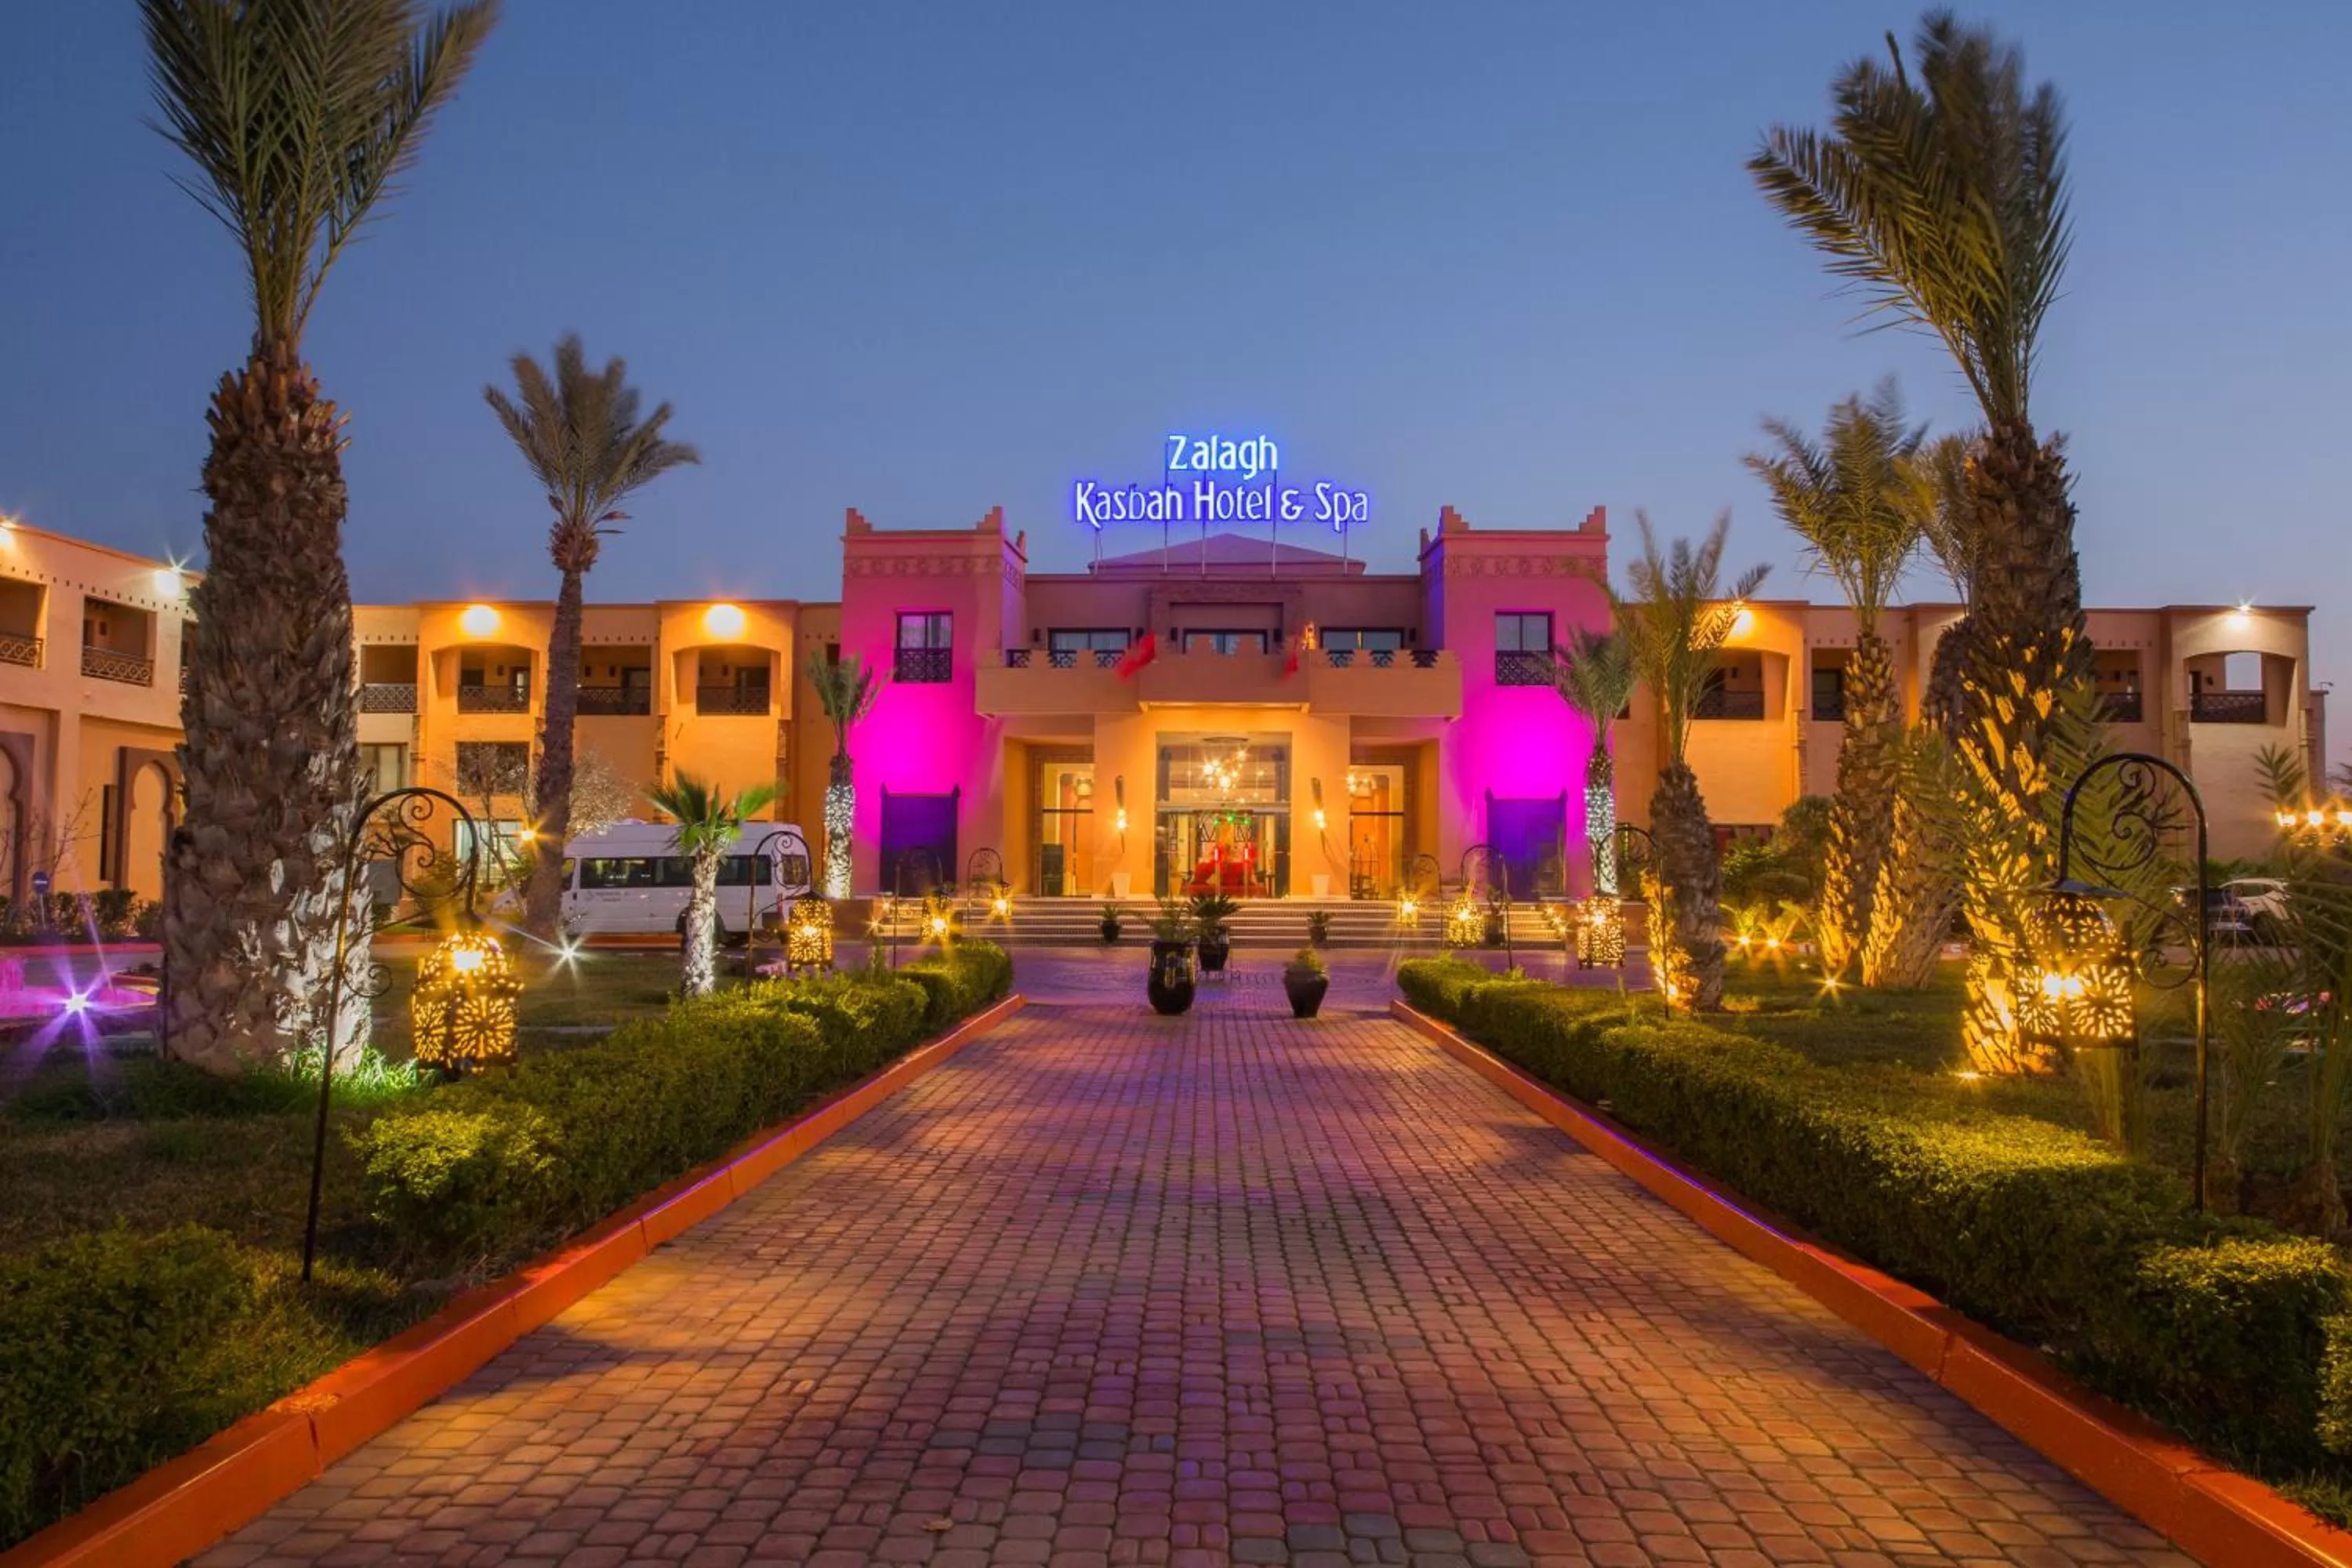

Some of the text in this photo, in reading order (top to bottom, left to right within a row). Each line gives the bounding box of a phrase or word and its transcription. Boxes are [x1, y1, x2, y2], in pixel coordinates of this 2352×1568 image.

[1169, 434, 1278, 480] Zalagh
[1076, 481, 1369, 532] Kasbah Hotel & Spa
